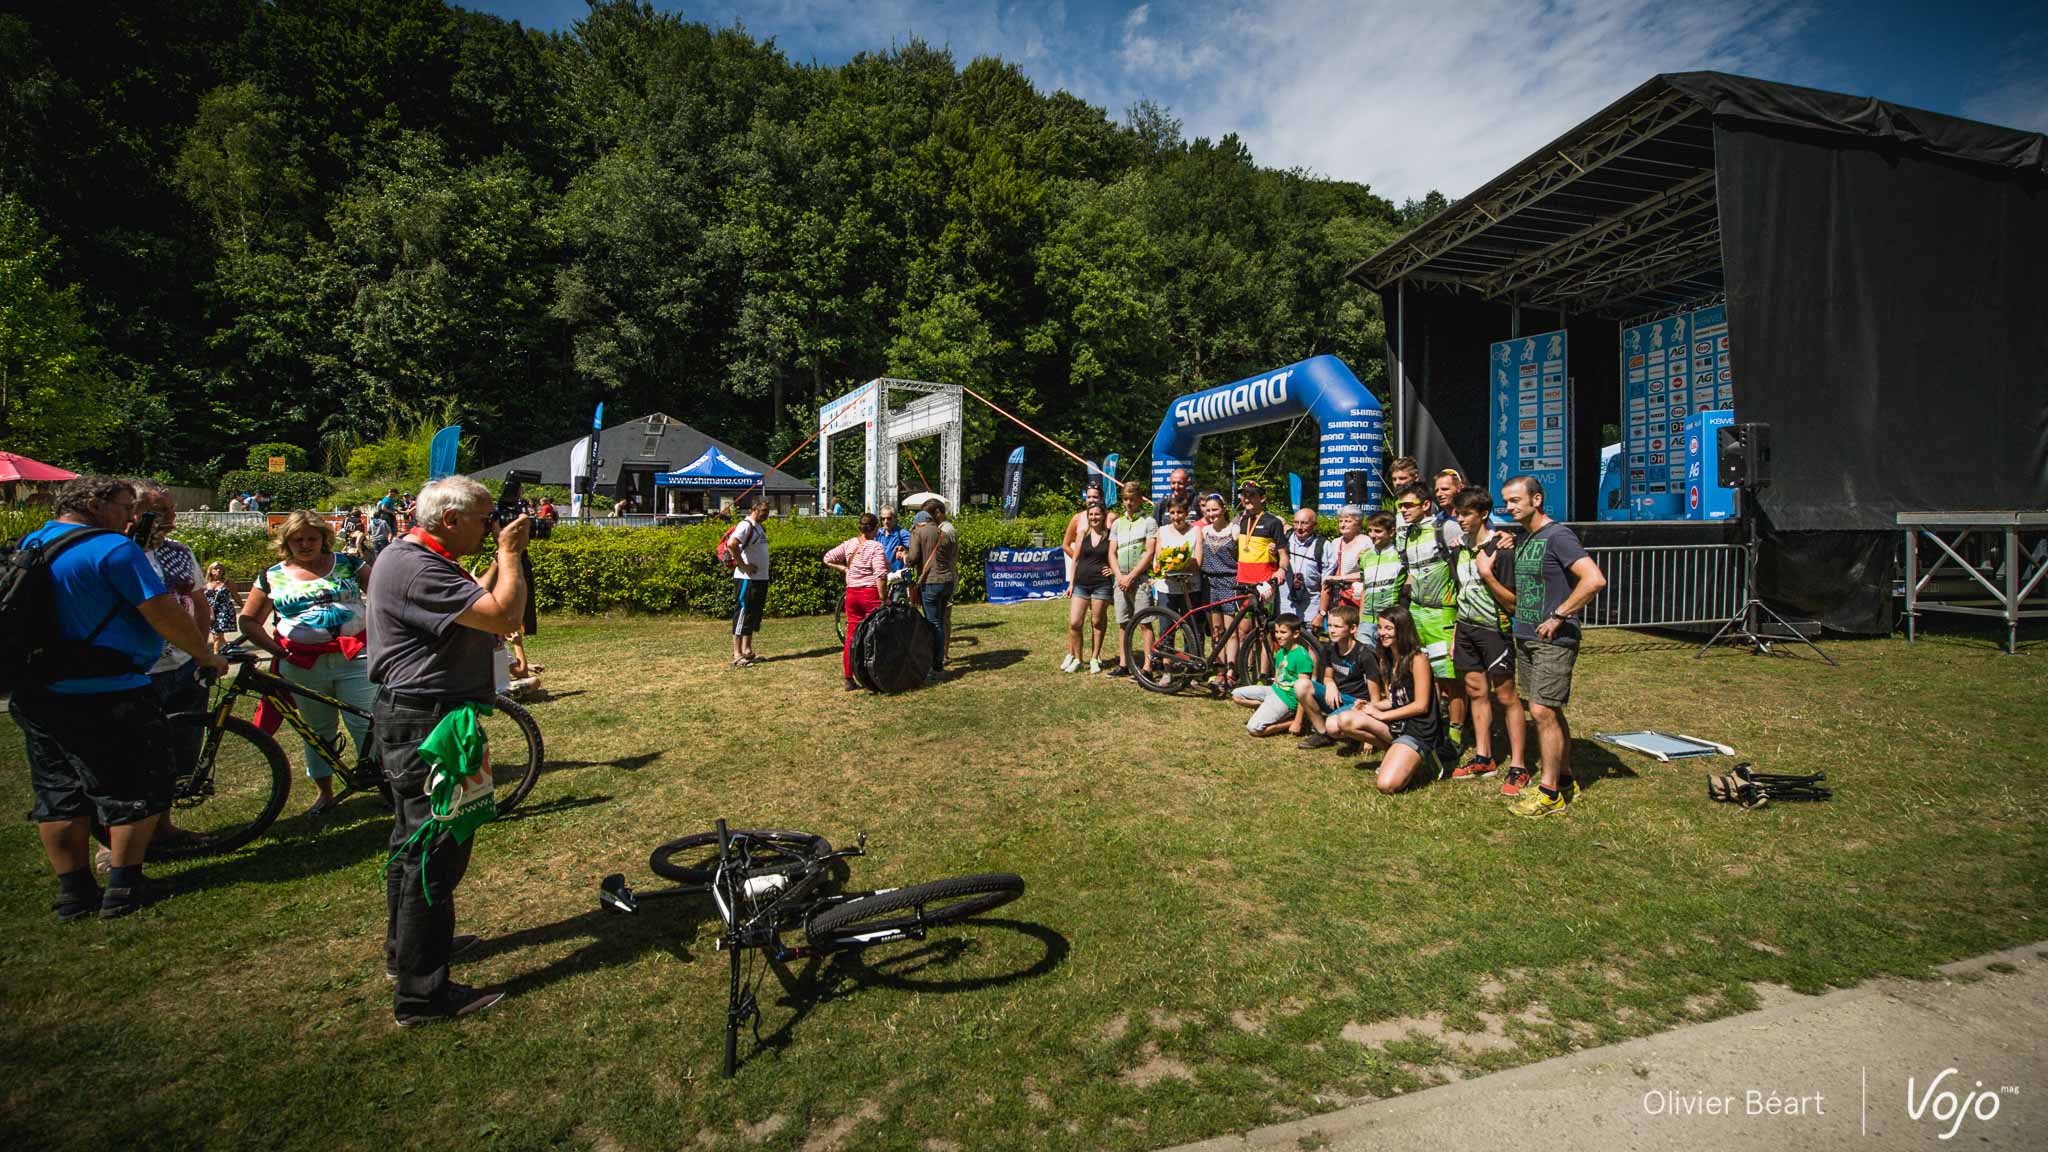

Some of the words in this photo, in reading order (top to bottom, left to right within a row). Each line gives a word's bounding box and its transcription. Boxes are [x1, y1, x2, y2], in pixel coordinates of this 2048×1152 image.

[1175, 372, 1287, 427] SHIMANO
[669, 476, 753, 486] www.shimano.com
[988, 551, 1009, 562] DE
[1012, 551, 1051, 563] KOCK
